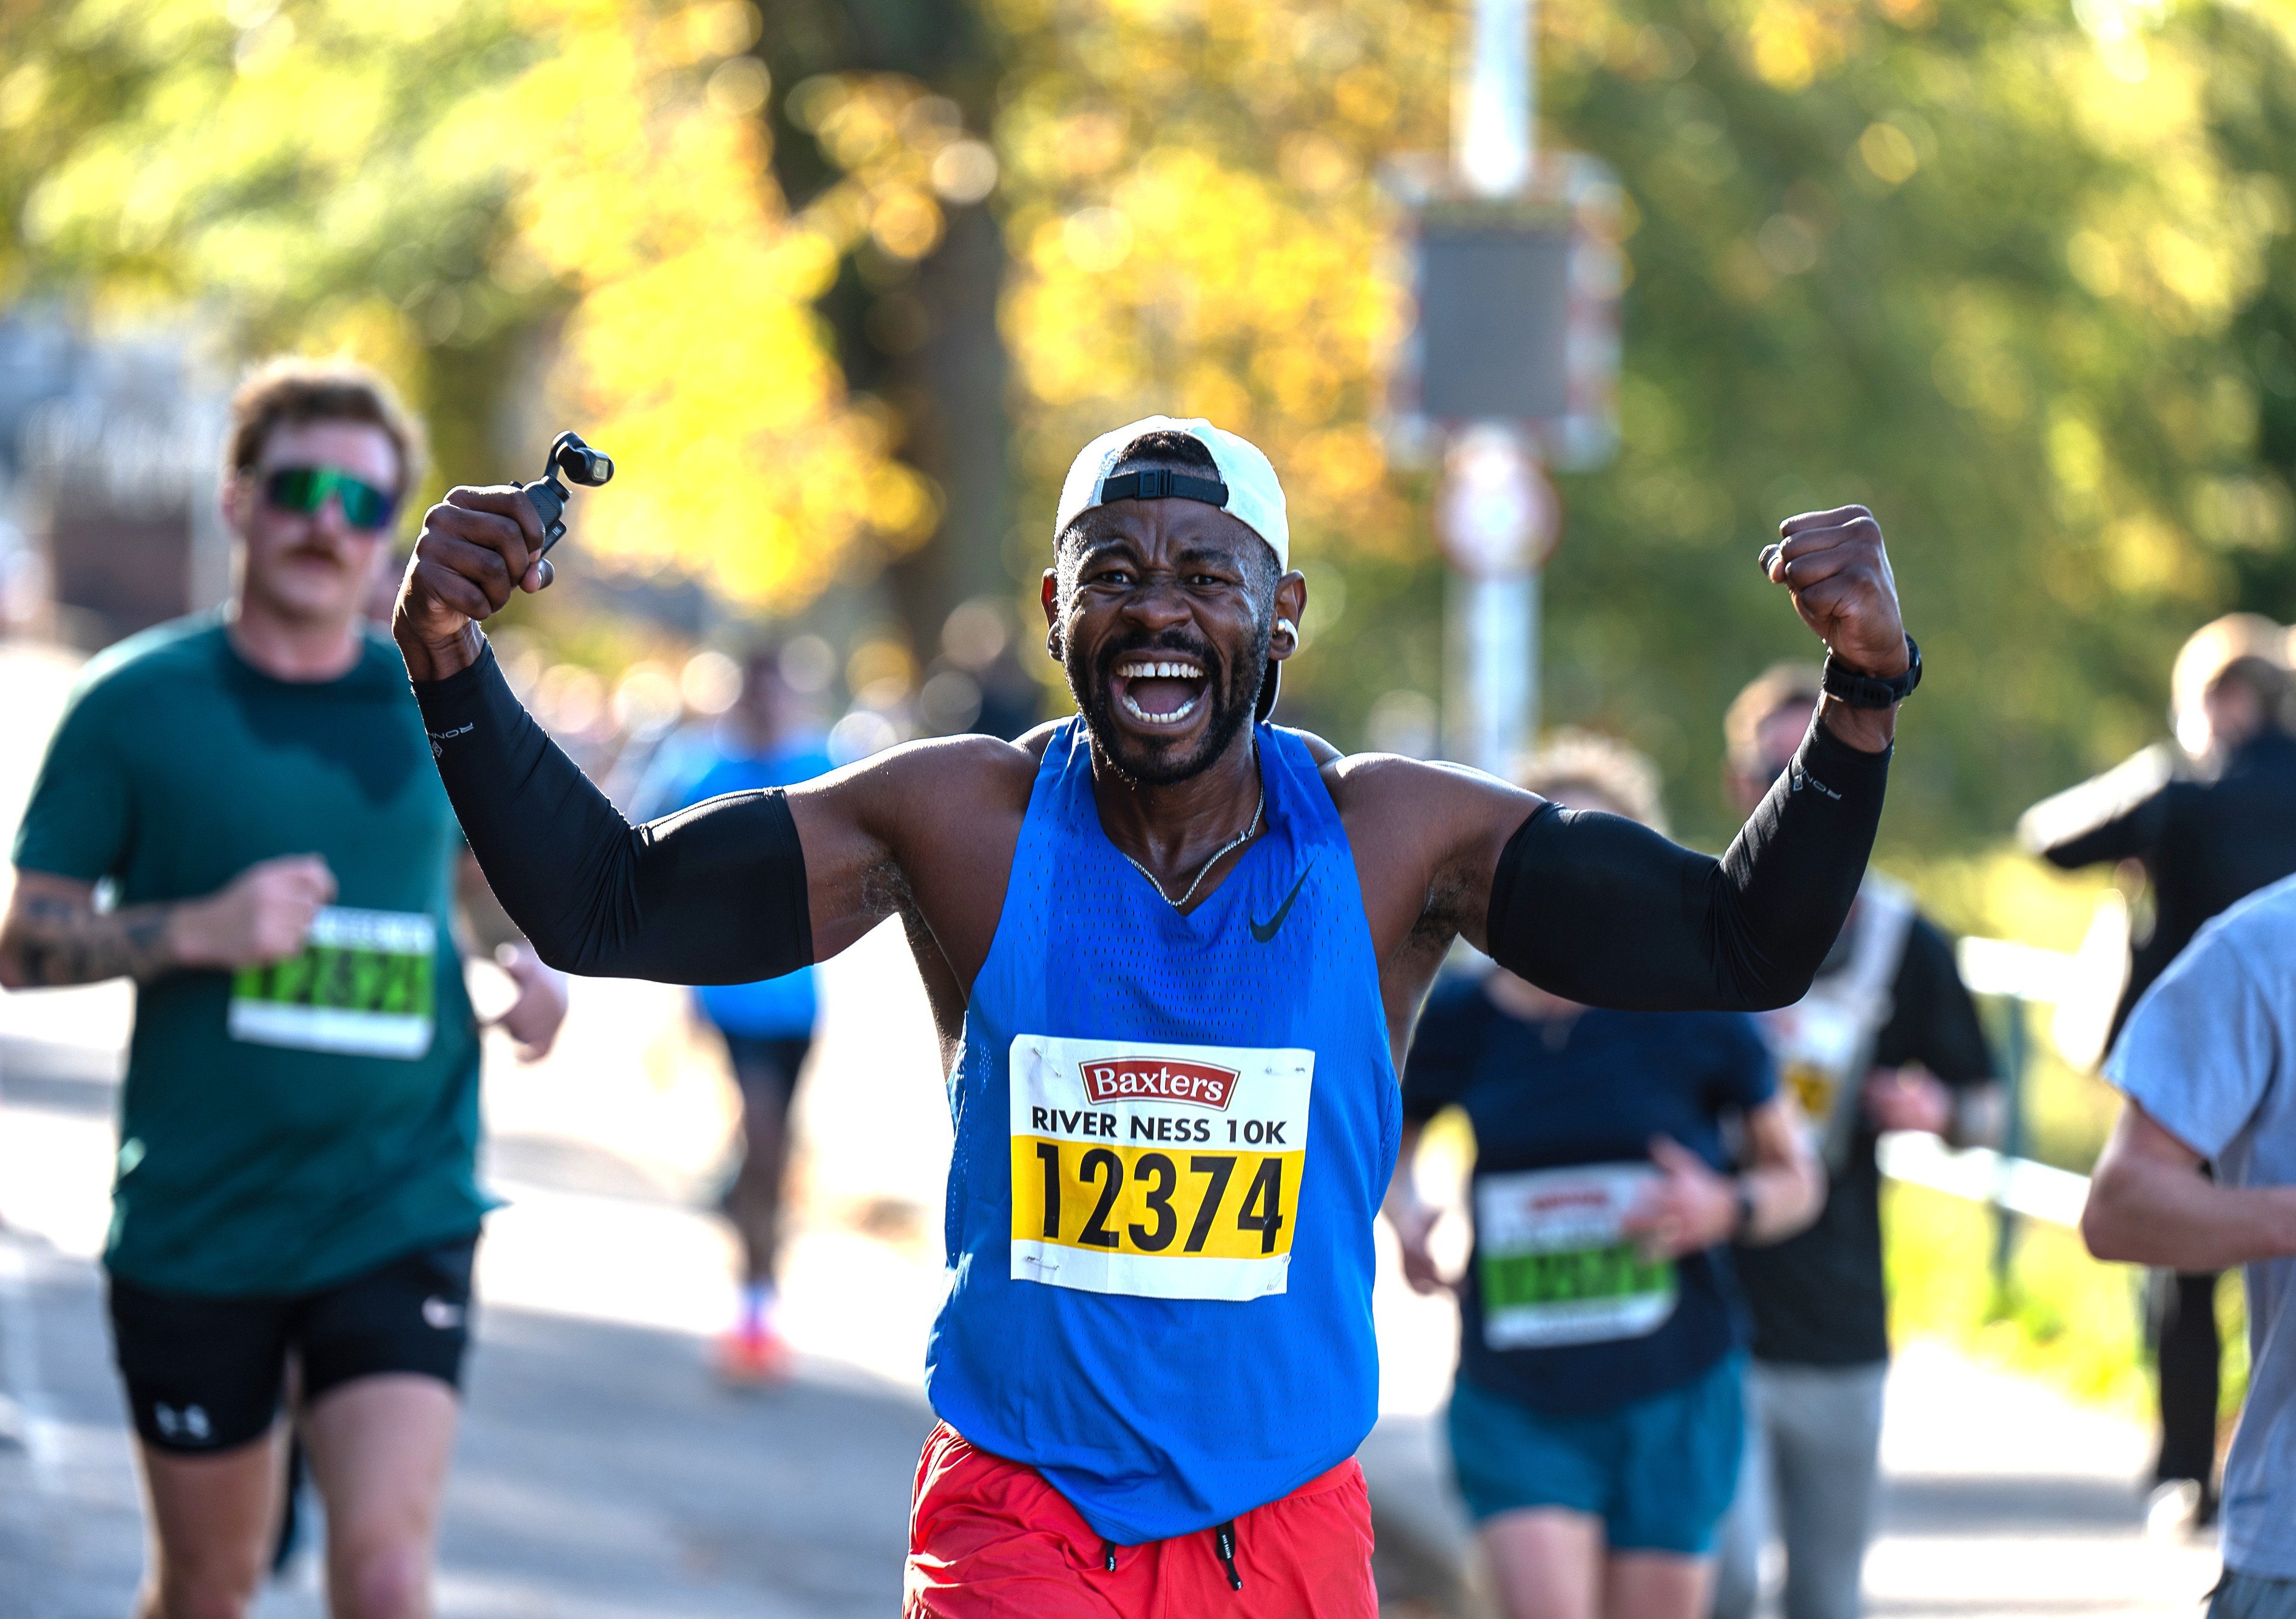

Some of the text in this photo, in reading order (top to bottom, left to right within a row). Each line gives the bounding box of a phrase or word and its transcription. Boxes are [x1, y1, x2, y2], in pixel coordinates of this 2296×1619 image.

[1093, 1066, 1224, 1102] Baxters
[1032, 1106, 1286, 1144] RIVER NESS 10K
[1036, 1142, 1283, 1255] 12374
